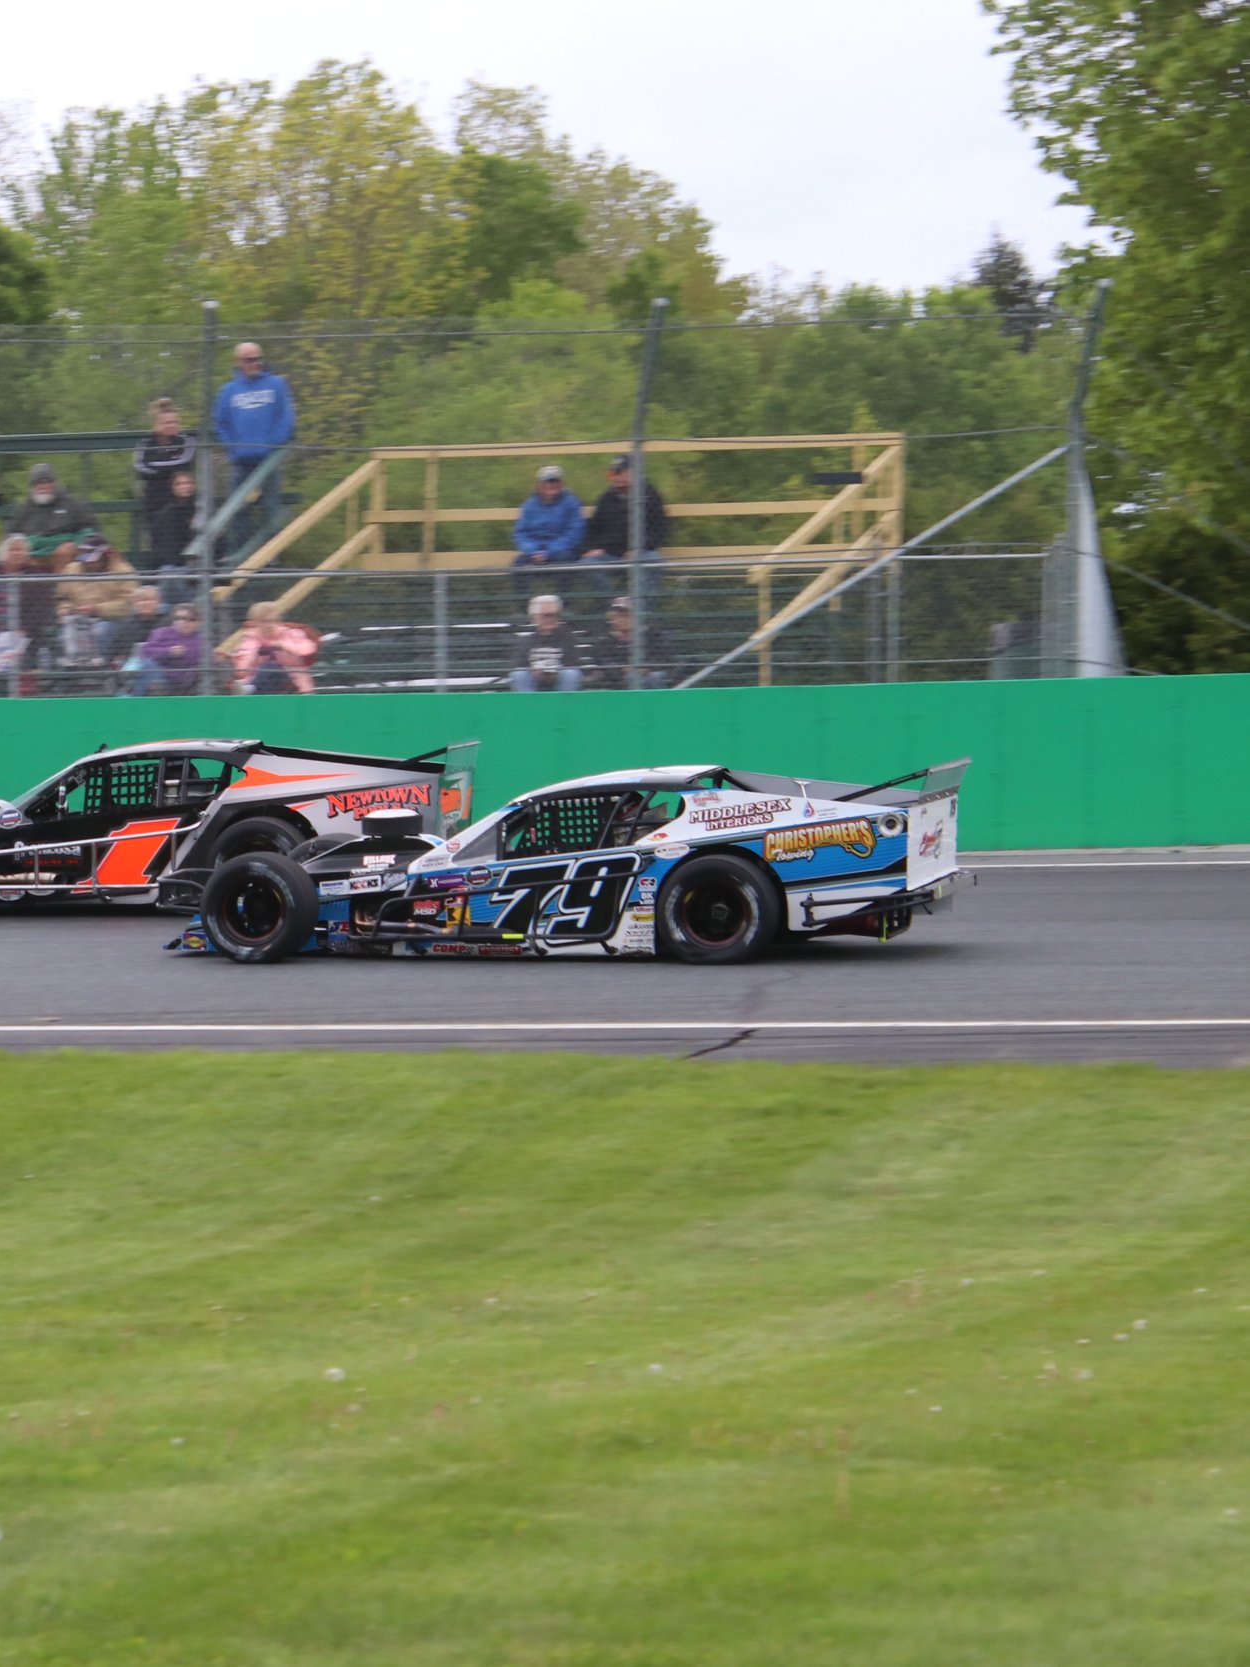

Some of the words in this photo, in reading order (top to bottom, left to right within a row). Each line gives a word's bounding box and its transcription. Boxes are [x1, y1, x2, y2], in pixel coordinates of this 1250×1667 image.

[326, 784, 431, 818] NEWTOWN
[689, 799, 791, 823] MIDDLESEX
[705, 812, 774, 831] INTERIORS
[766, 820, 873, 861] CHRISTOPHER'S
[70, 816, 181, 895] 1
[773, 850, 814, 864] Towing
[413, 908, 437, 916] MSD
[491, 851, 642, 945] 79
